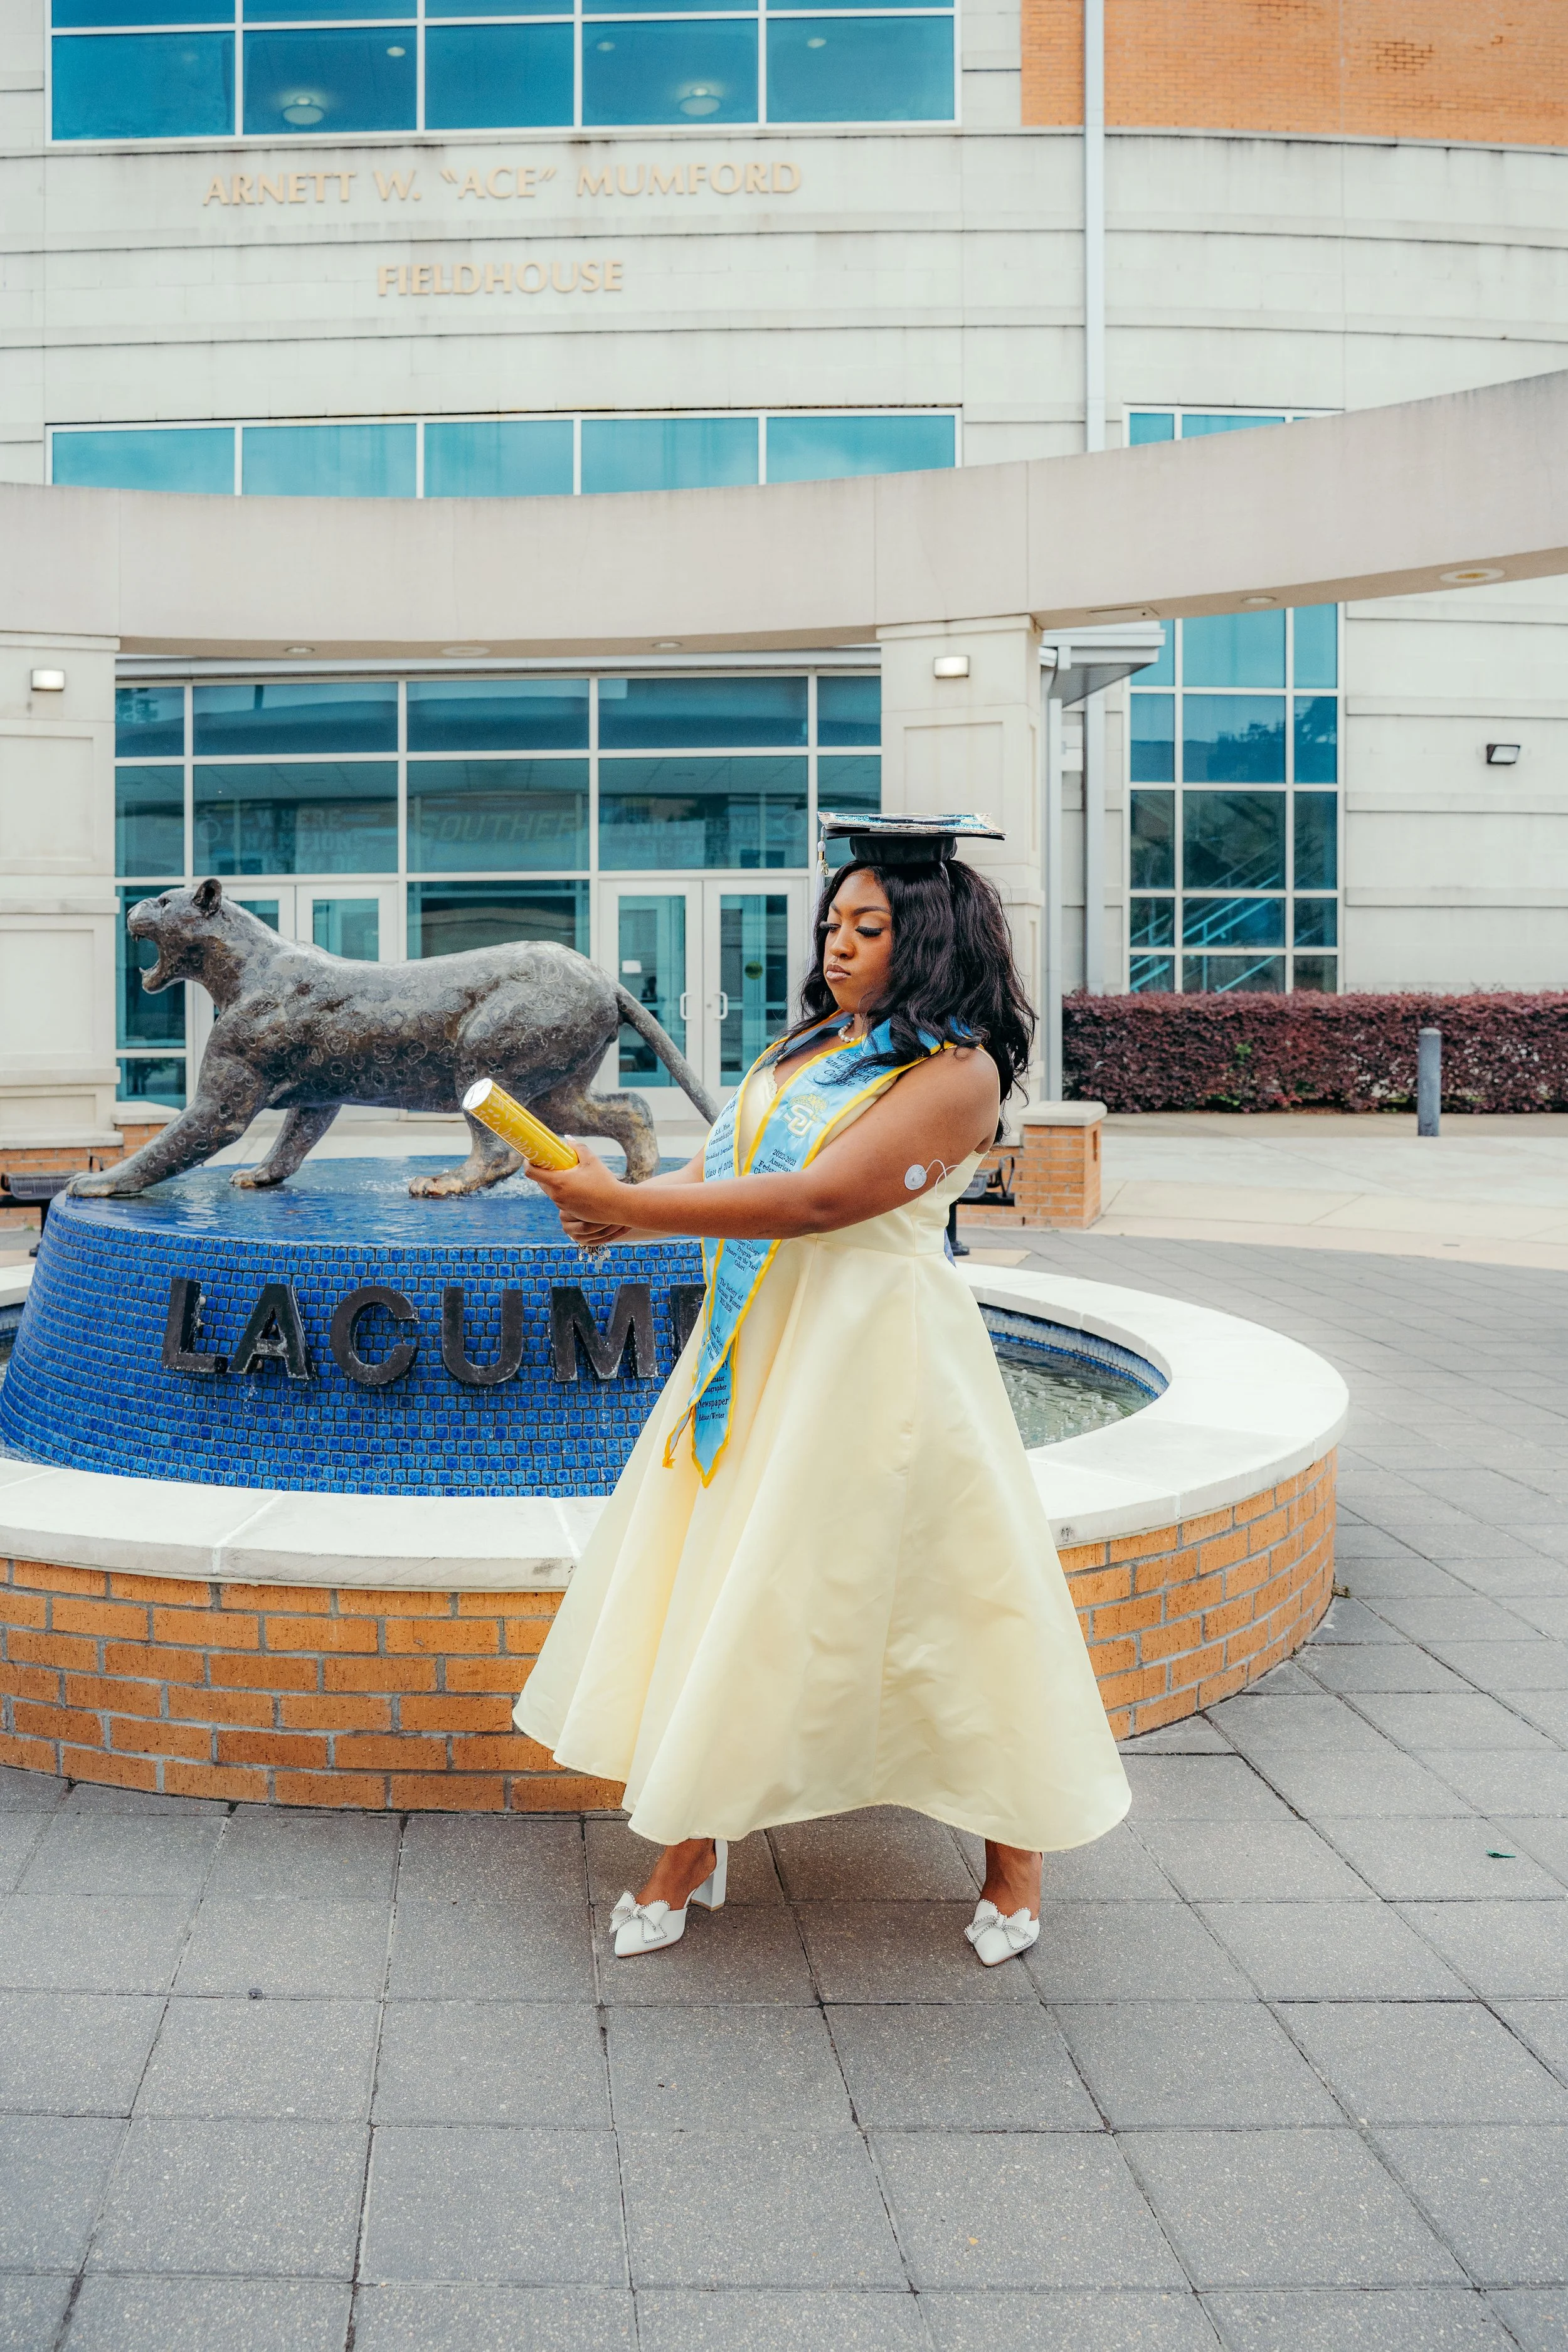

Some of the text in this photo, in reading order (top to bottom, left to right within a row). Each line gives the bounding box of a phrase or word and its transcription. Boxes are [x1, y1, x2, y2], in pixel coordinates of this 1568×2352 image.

[202, 171, 357, 206] ARNETT
[374, 169, 422, 201] W.
[575, 161, 803, 197] MUMFORD
[378, 259, 625, 296] FIELDHOUSE
[772, 1148, 797, 1167] 2022-2023
[706, 1158, 734, 1179] Class of 2026
[737, 1246, 751, 1259] Program
[746, 1244, 760, 1256] College
[704, 1384, 728, 1394] otographer
[697, 1398, 729, 1410] Newspaper
[699, 1412, 725, 1422] Editor/Writer
